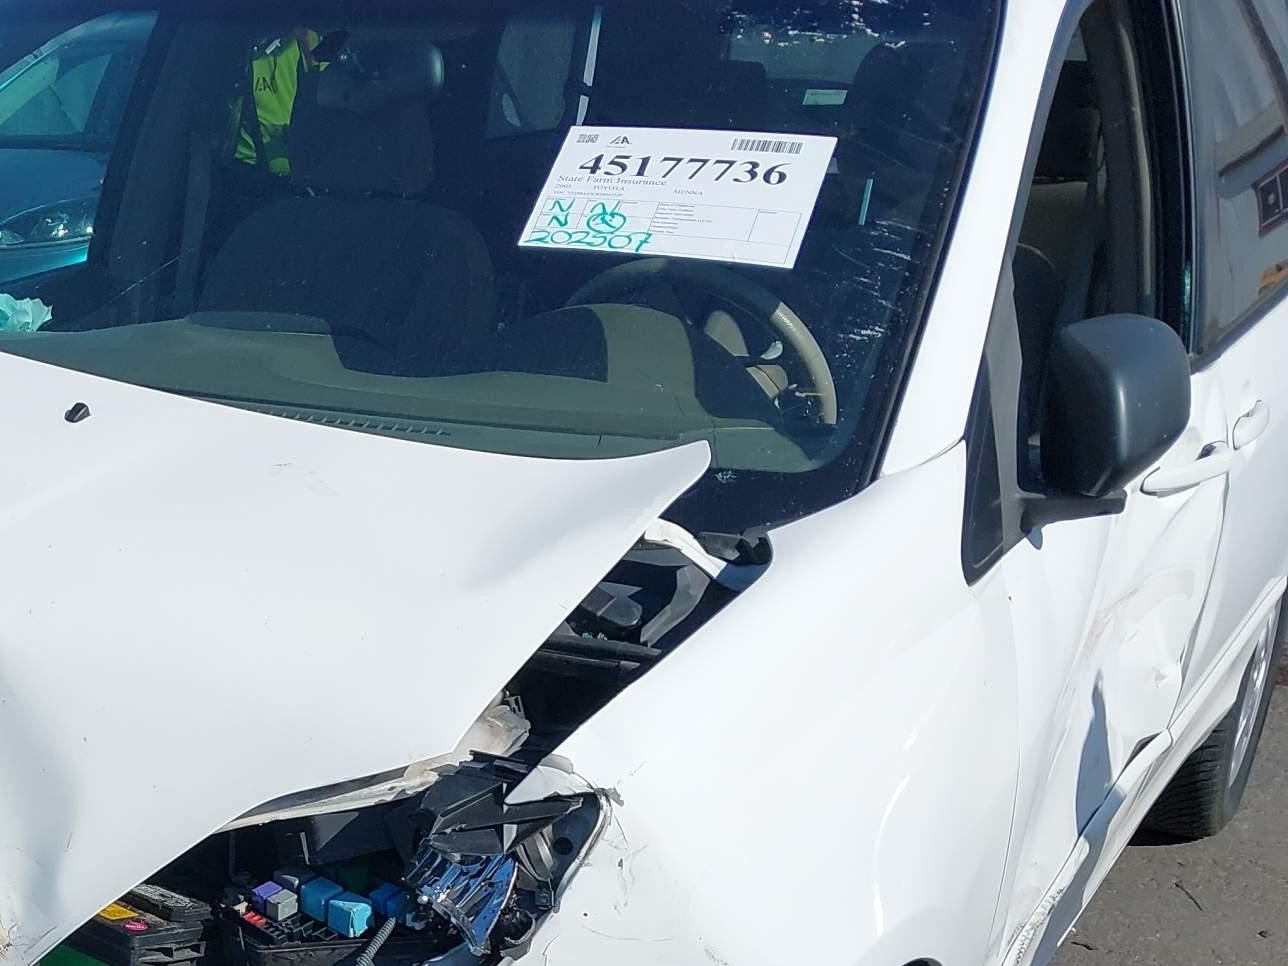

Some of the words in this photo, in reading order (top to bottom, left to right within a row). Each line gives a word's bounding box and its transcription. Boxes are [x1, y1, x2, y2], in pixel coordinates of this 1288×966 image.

[579, 153, 793, 186] 45177736
[558, 175, 584, 183] State
[586, 175, 613, 184] Farm
[615, 177, 668, 187] Insurance
